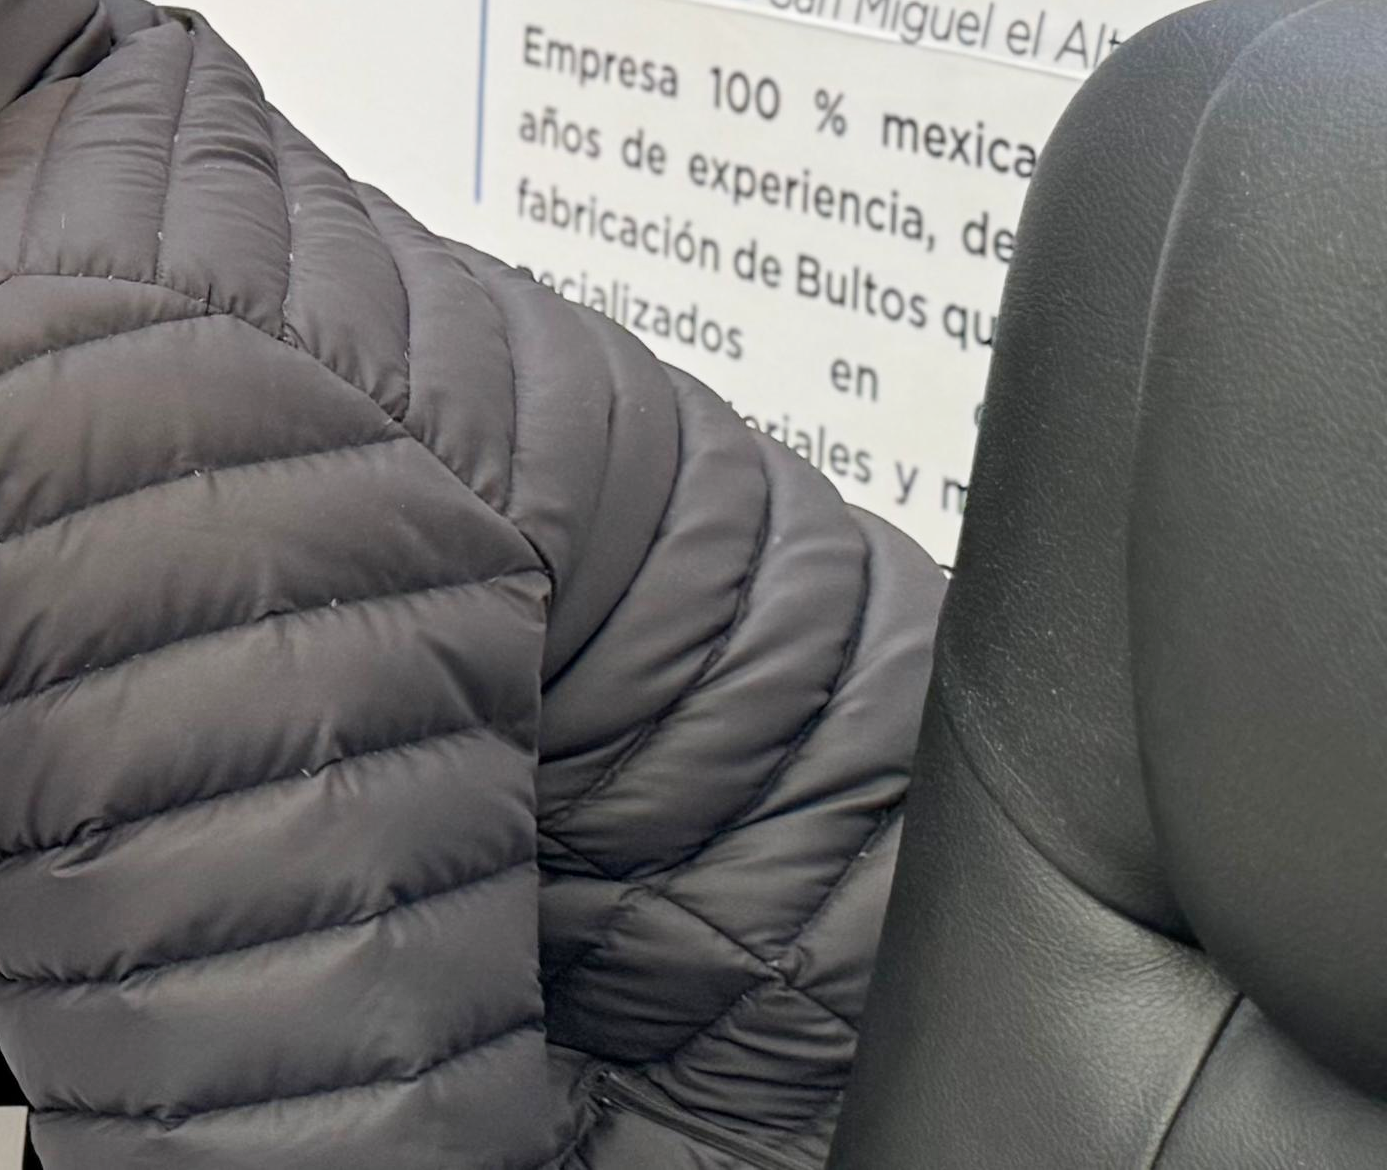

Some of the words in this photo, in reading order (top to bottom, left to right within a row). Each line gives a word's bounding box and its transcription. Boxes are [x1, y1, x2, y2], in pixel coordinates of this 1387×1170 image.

[1006, 9, 1046, 58] el
[1053, 19, 1123, 70] Alt
[522, 25, 679, 99] Empresa
[710, 66, 782, 122] 100
[815, 87, 849, 137] %
[881, 112, 1037, 179] mexica
[519, 106, 601, 161] años
[621, 129, 667, 177] de
[688, 148, 937, 252] experiencia,
[962, 211, 1017, 263] de
[516, 178, 721, 273] fabricación
[734, 240, 783, 288] de
[796, 254, 929, 329] Bultos
[942, 302, 996, 350] qu
[517, 265, 744, 360] cializados
[830, 358, 880, 403] en
[895, 460, 919, 506] y
